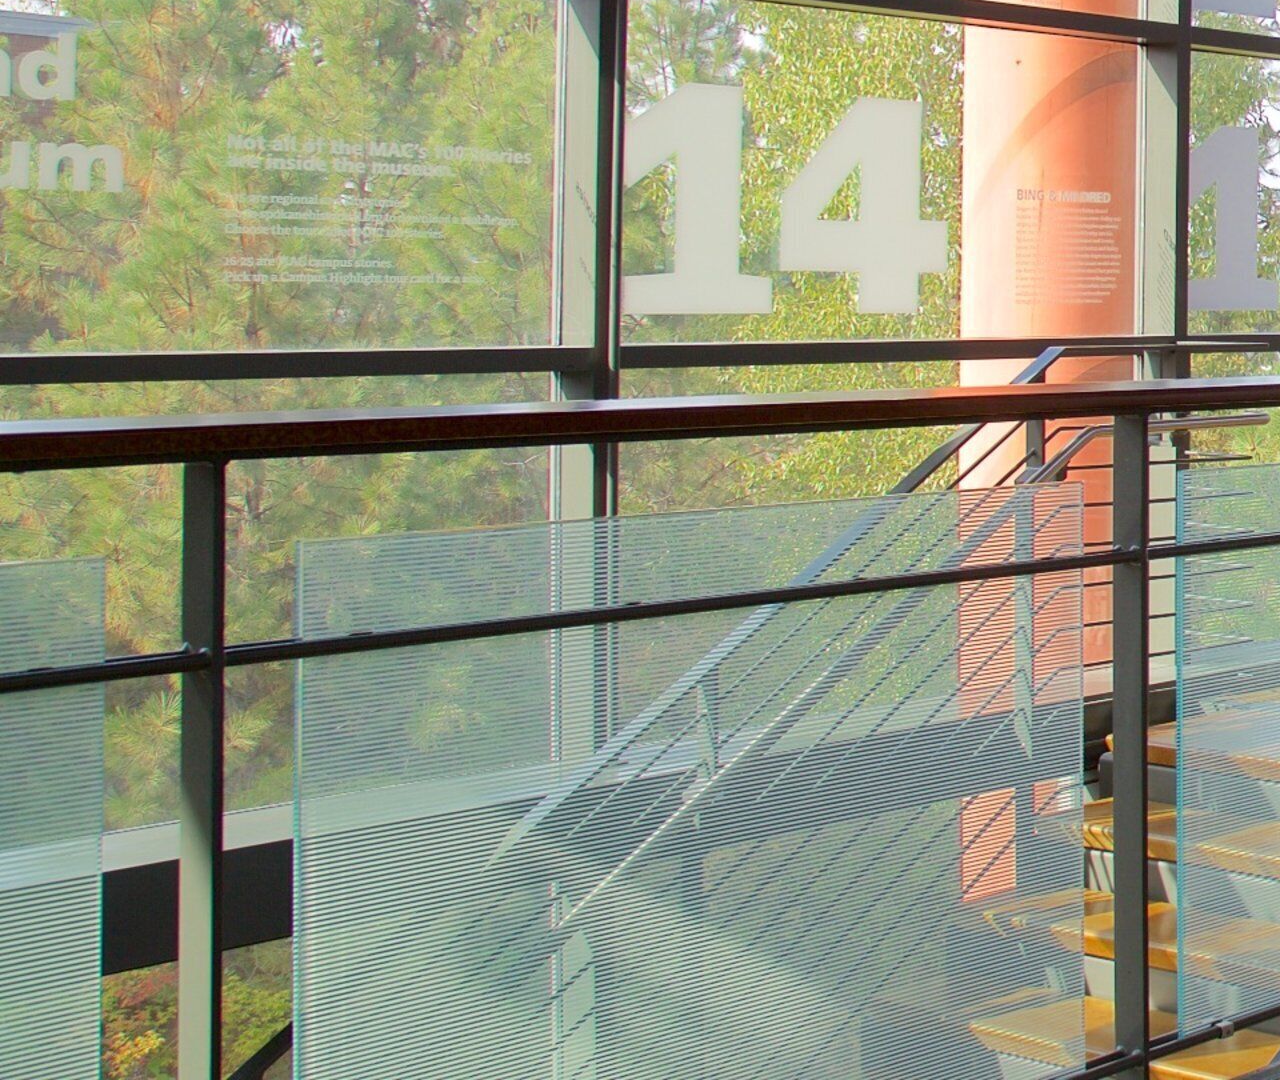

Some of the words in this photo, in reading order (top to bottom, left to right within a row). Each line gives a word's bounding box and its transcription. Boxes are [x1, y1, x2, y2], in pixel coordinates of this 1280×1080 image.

[0, 31, 78, 101] d
[226, 133, 265, 152] Not
[272, 134, 297, 153] all
[302, 136, 326, 154] of
[331, 138, 364, 156] the
[369, 140, 429, 160] MAC's
[227, 156, 260, 170] are
[264, 156, 328, 171] inside
[333, 159, 366, 174] the
[621, 81, 948, 315] 14
[1016, 188, 1045, 201] BING
[1048, 190, 1058, 201] &
